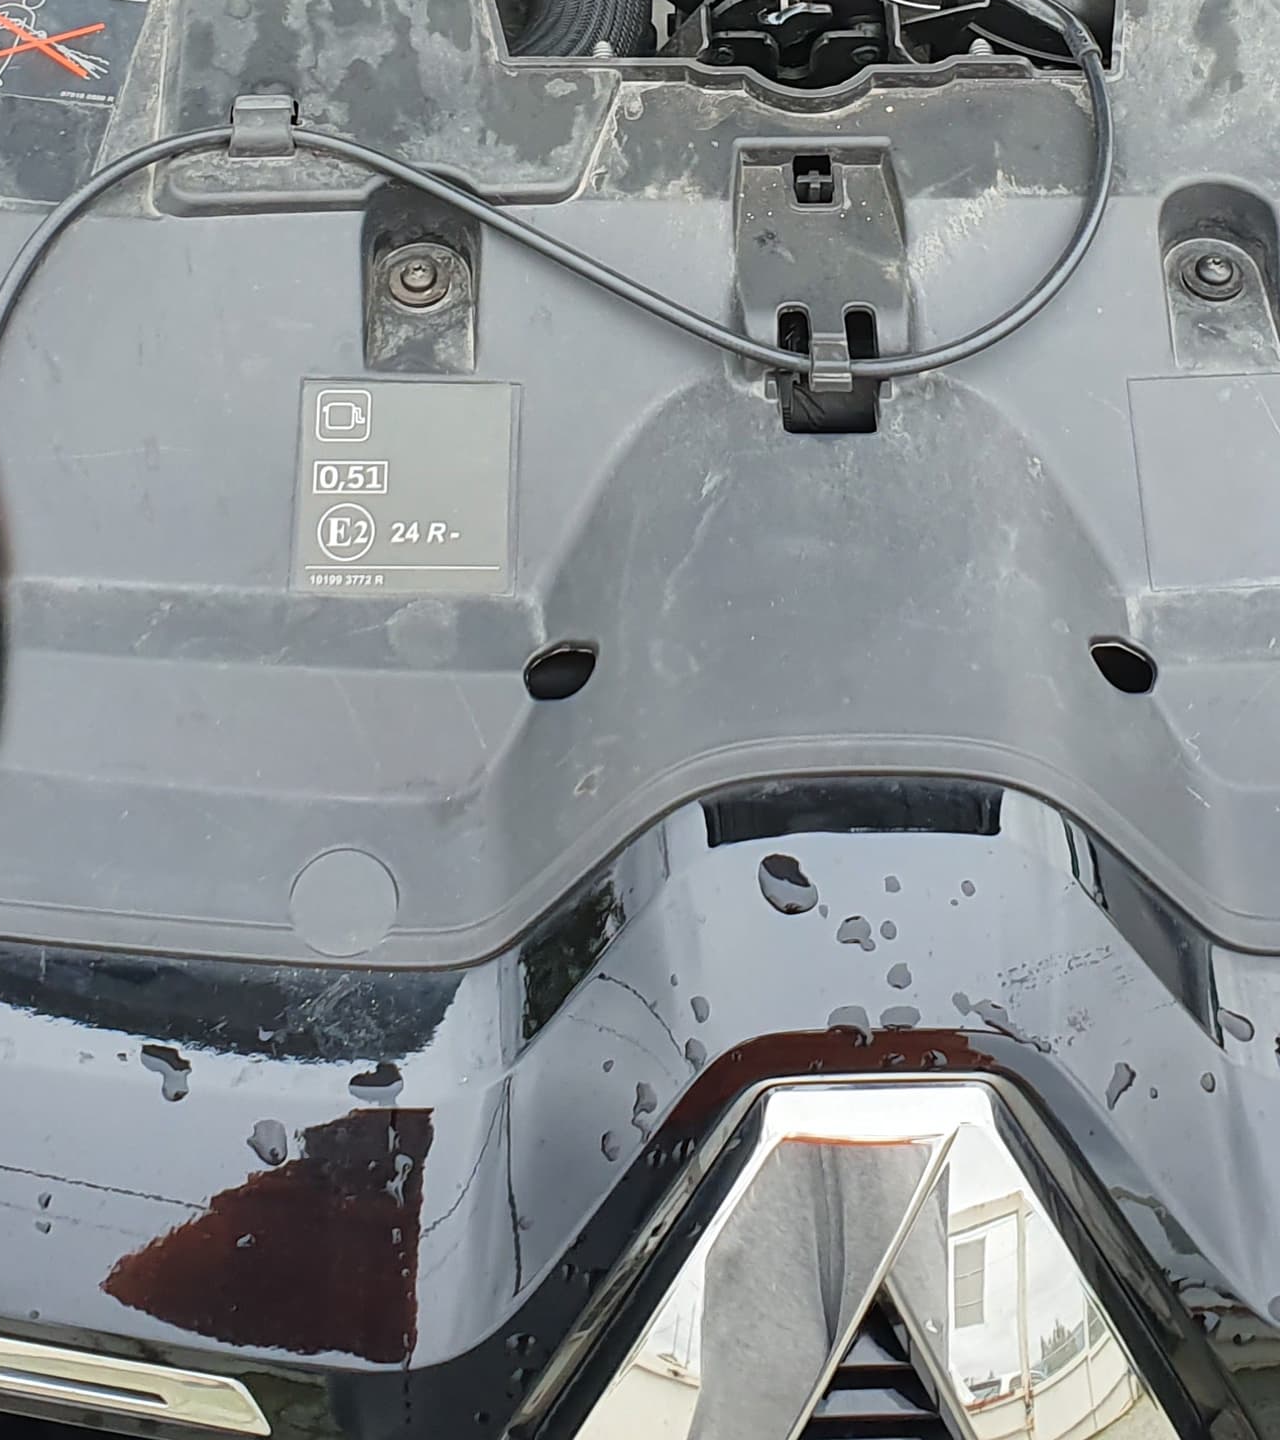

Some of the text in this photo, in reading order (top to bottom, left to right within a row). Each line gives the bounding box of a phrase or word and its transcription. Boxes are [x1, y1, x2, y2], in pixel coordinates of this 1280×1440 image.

[320, 465, 383, 492] 0,51
[326, 517, 369, 548] E2
[391, 522, 420, 544] 24
[374, 574, 384, 586] R
